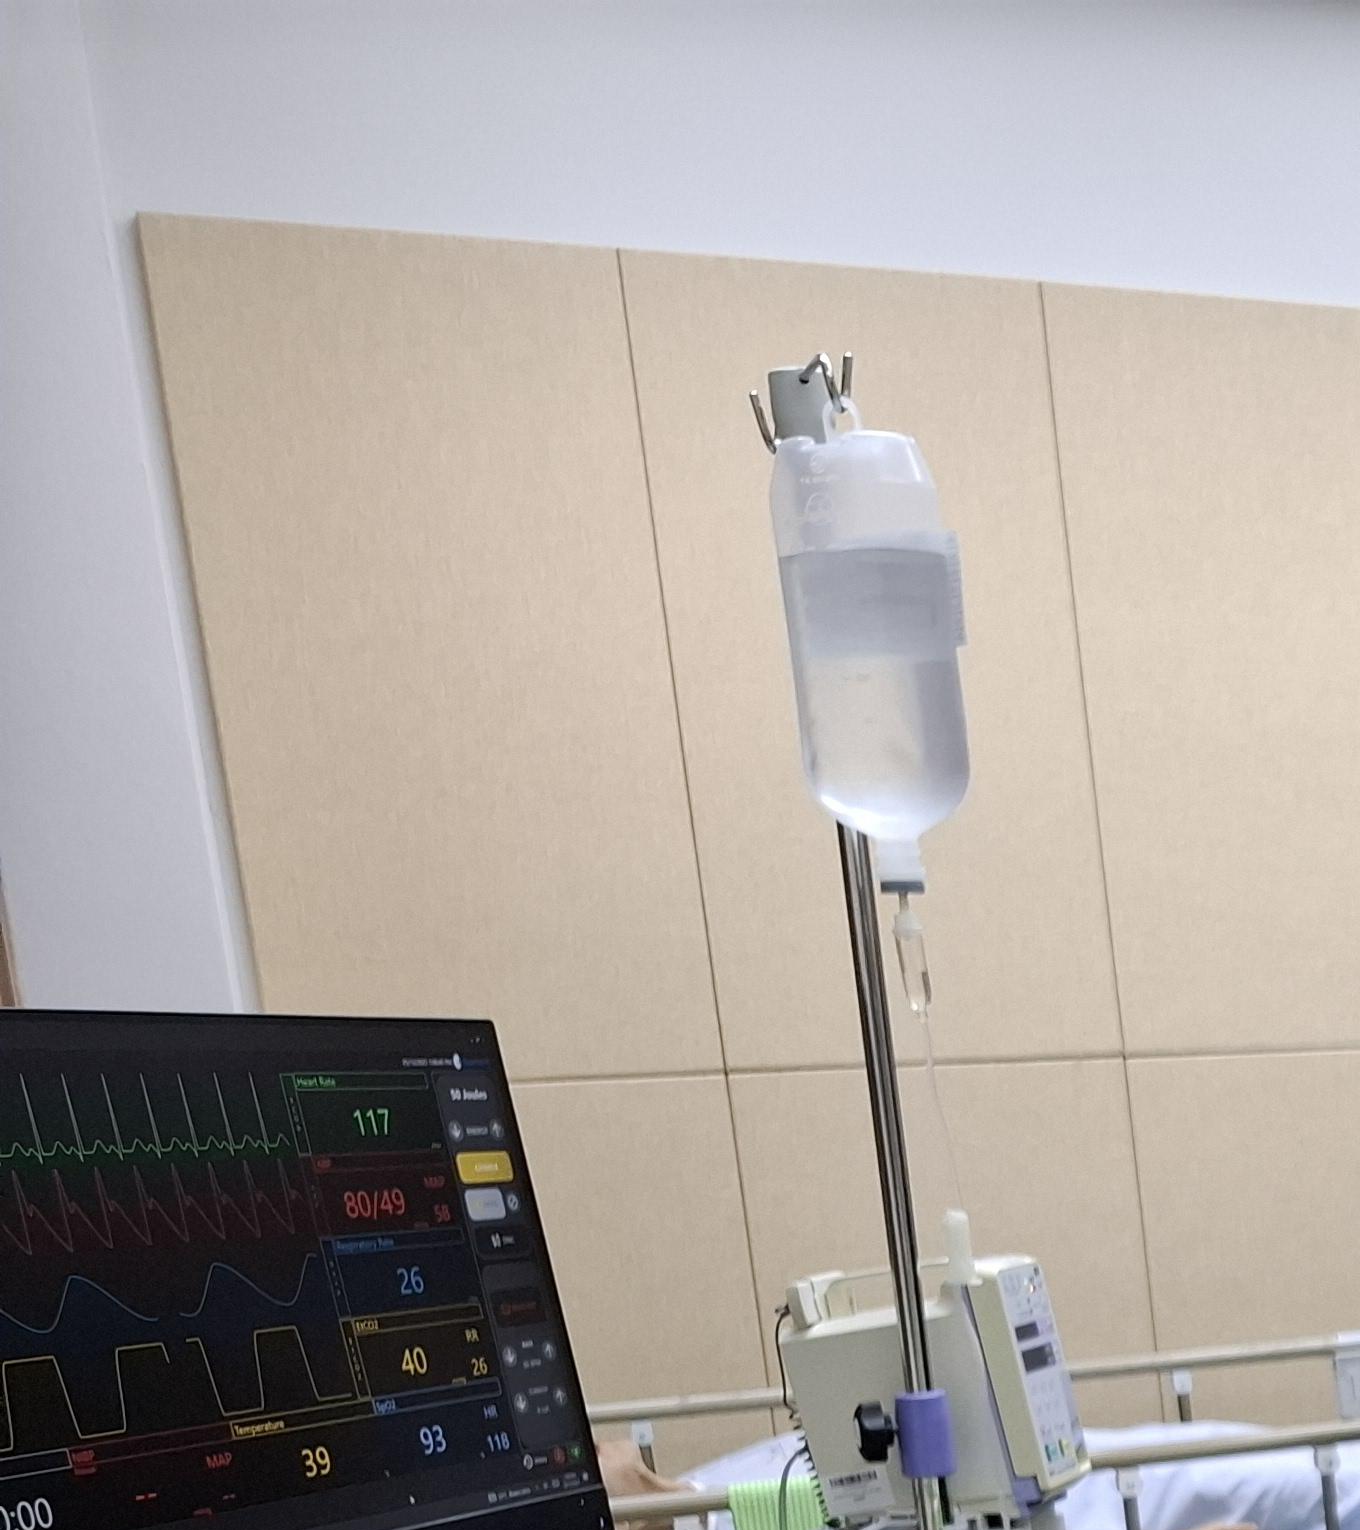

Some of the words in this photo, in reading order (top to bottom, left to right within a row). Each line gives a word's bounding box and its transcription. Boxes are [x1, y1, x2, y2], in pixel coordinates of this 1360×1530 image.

[353, 1108, 390, 1137] 117
[343, 1187, 406, 1220] 80/49
[396, 1265, 425, 1295] 26
[465, 1328, 480, 1343] RR
[401, 1346, 428, 1375] 40
[471, 1357, 488, 1377] 26
[483, 1404, 499, 1420] HR
[233, 1420, 285, 1437] Temperature
[419, 1424, 447, 1455] 93
[487, 1431, 511, 1452] 118
[206, 1451, 233, 1469] MAP
[301, 1446, 331, 1478] 39
